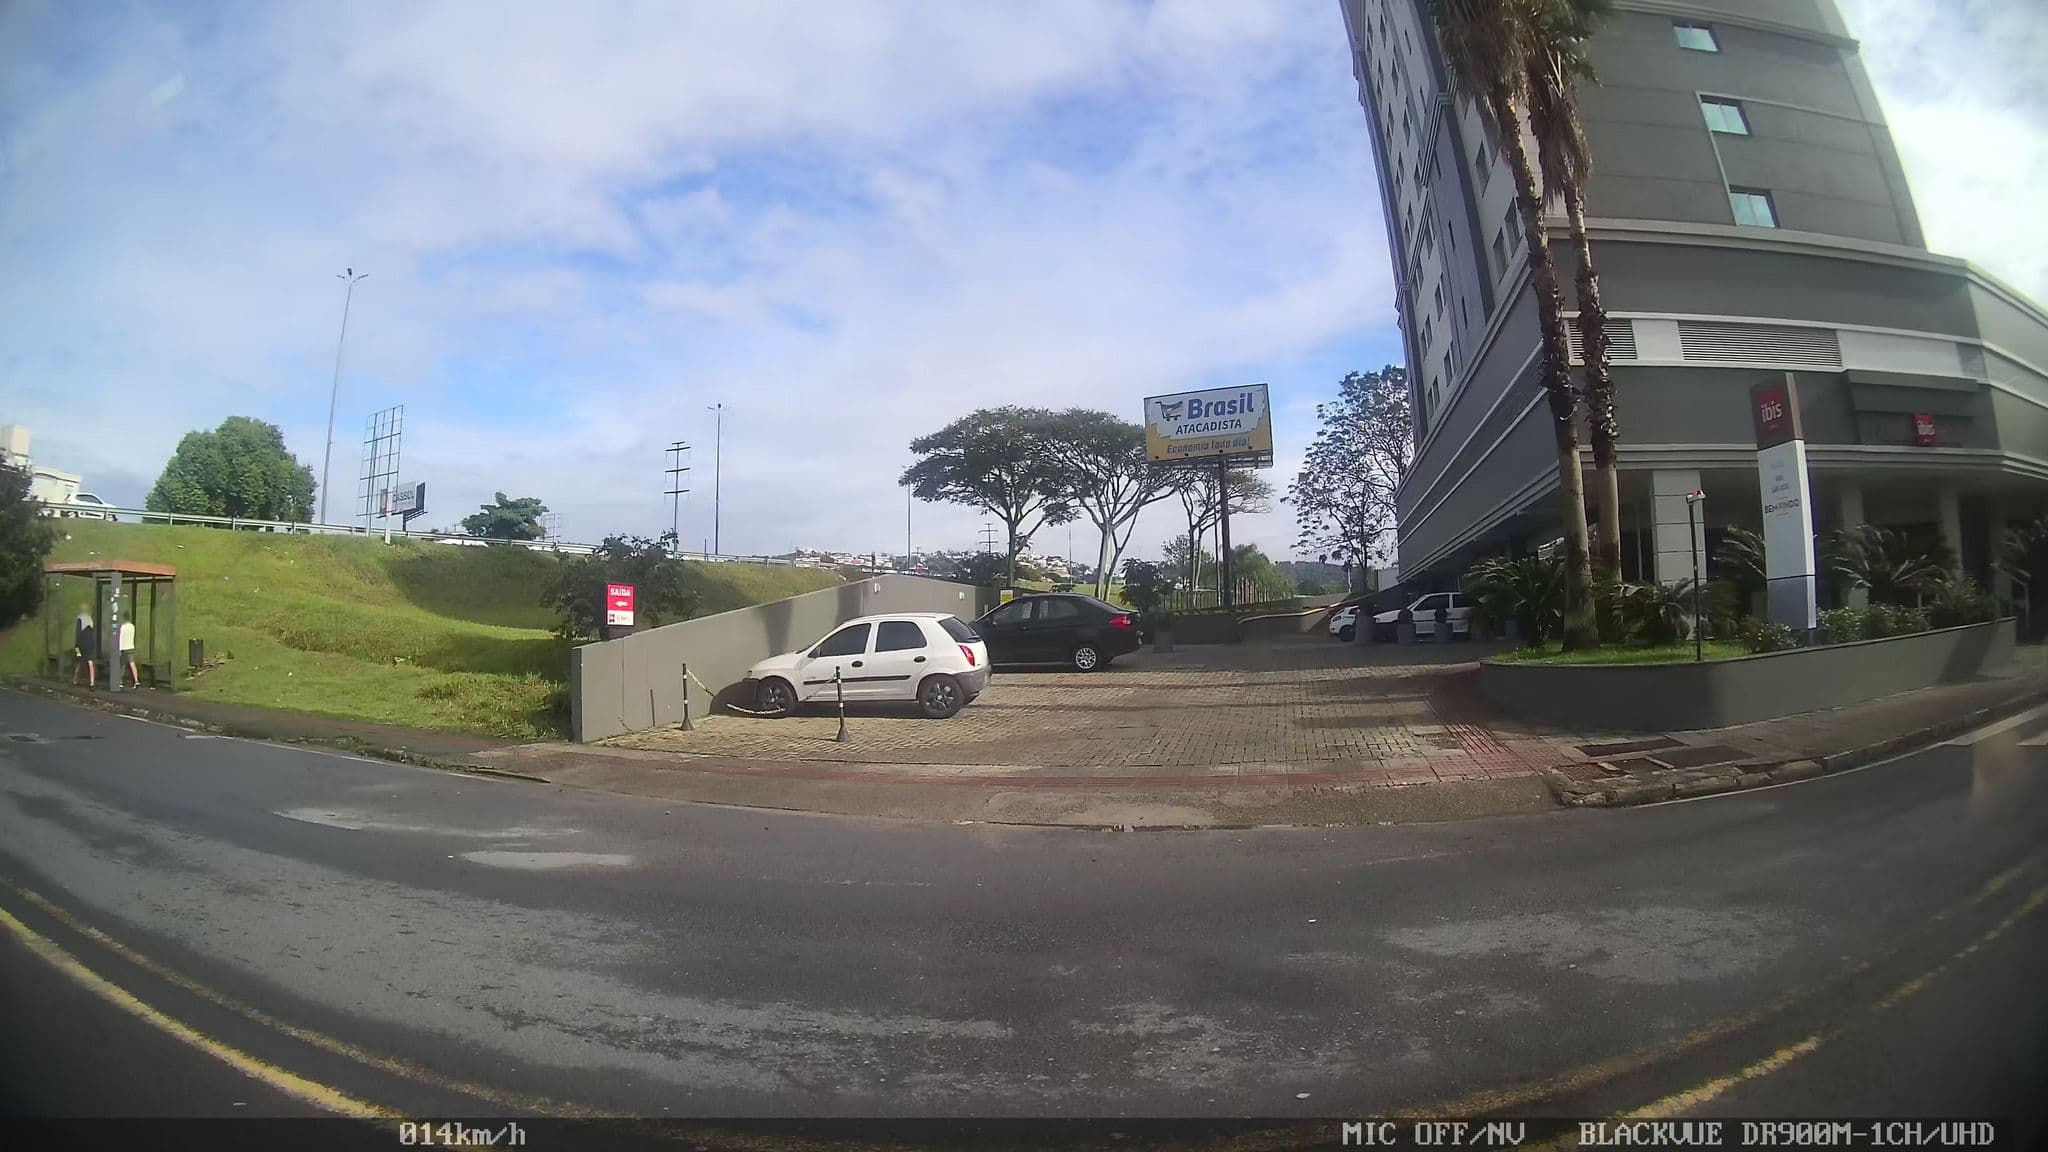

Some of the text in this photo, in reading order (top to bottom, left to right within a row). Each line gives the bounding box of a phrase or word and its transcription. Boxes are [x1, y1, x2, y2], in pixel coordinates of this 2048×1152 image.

[1187, 392, 1254, 420] Brasil
[1761, 401, 1783, 422] ibis
[1175, 418, 1242, 435] ATACADISTA
